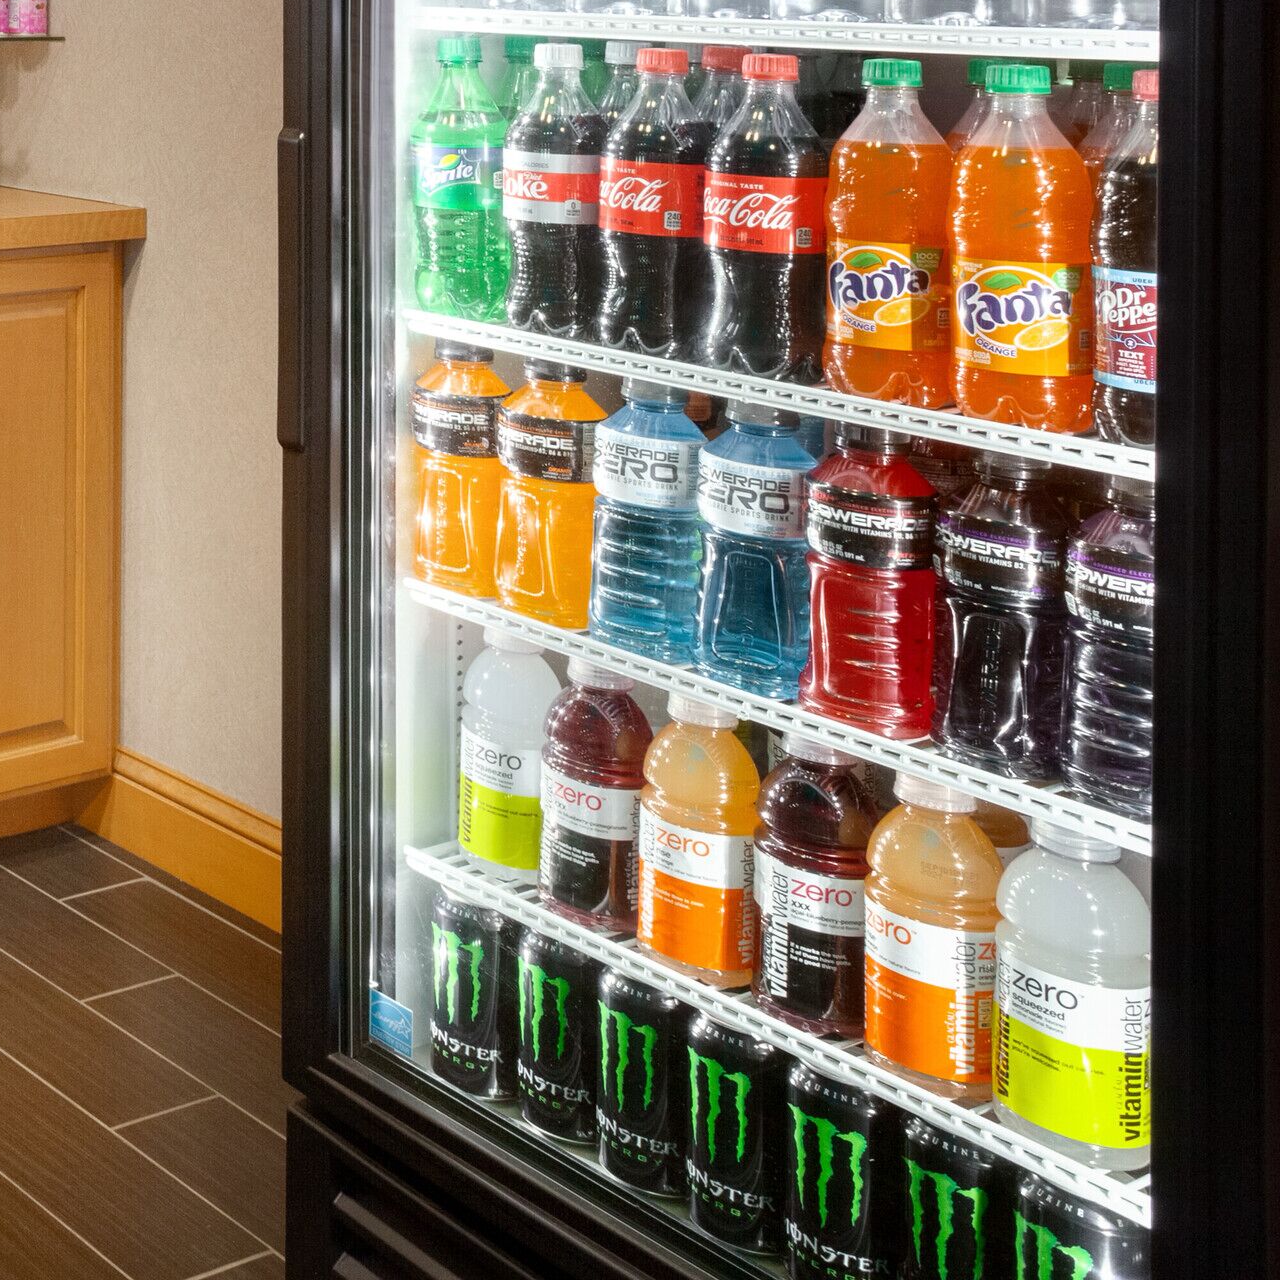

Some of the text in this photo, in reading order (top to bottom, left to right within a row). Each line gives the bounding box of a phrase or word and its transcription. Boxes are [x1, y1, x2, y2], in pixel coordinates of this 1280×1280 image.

[503, 172, 549, 199] oke
[829, 260, 930, 312] Fanta
[1116, 287, 1147, 308] Dr
[842, 312, 876, 333] ORANGE
[956, 281, 1072, 336] Fanta
[975, 337, 1016, 357] ORANGE
[1118, 349, 1145, 360] TEXT
[594, 435, 680, 464] POWERADE
[593, 449, 679, 484] ZERO
[698, 461, 791, 493] POWERADE
[655, 482, 679, 491] DRINK
[698, 476, 790, 515] ZERO
[730, 506, 790, 521] SPORTS DRINK
[808, 498, 929, 532] POWERADE
[860, 526, 893, 539] VITAMINS
[935, 522, 1057, 566] POWERADE
[978, 554, 1012, 568] VITAMINS
[1098, 588, 1116, 598] WITH
[475, 743, 522, 770] zero
[553, 781, 602, 811] zero
[656, 827, 710, 857] zero
[791, 878, 852, 908] zero
[769, 866, 789, 999] vitaminwater
[865, 906, 912, 946] zero
[1012, 968, 1078, 1011] zero
[948, 935, 976, 1075] vitaminwater
[1012, 991, 1066, 1022] squeezed
[1012, 1000, 1043, 1021] lemonade
[1118, 995, 1144, 1142] vitaminwater
[795, 1072, 859, 1107] TAURINE
[912, 1124, 981, 1161] TAURINE
[1022, 1176, 1086, 1219] TAURINE
